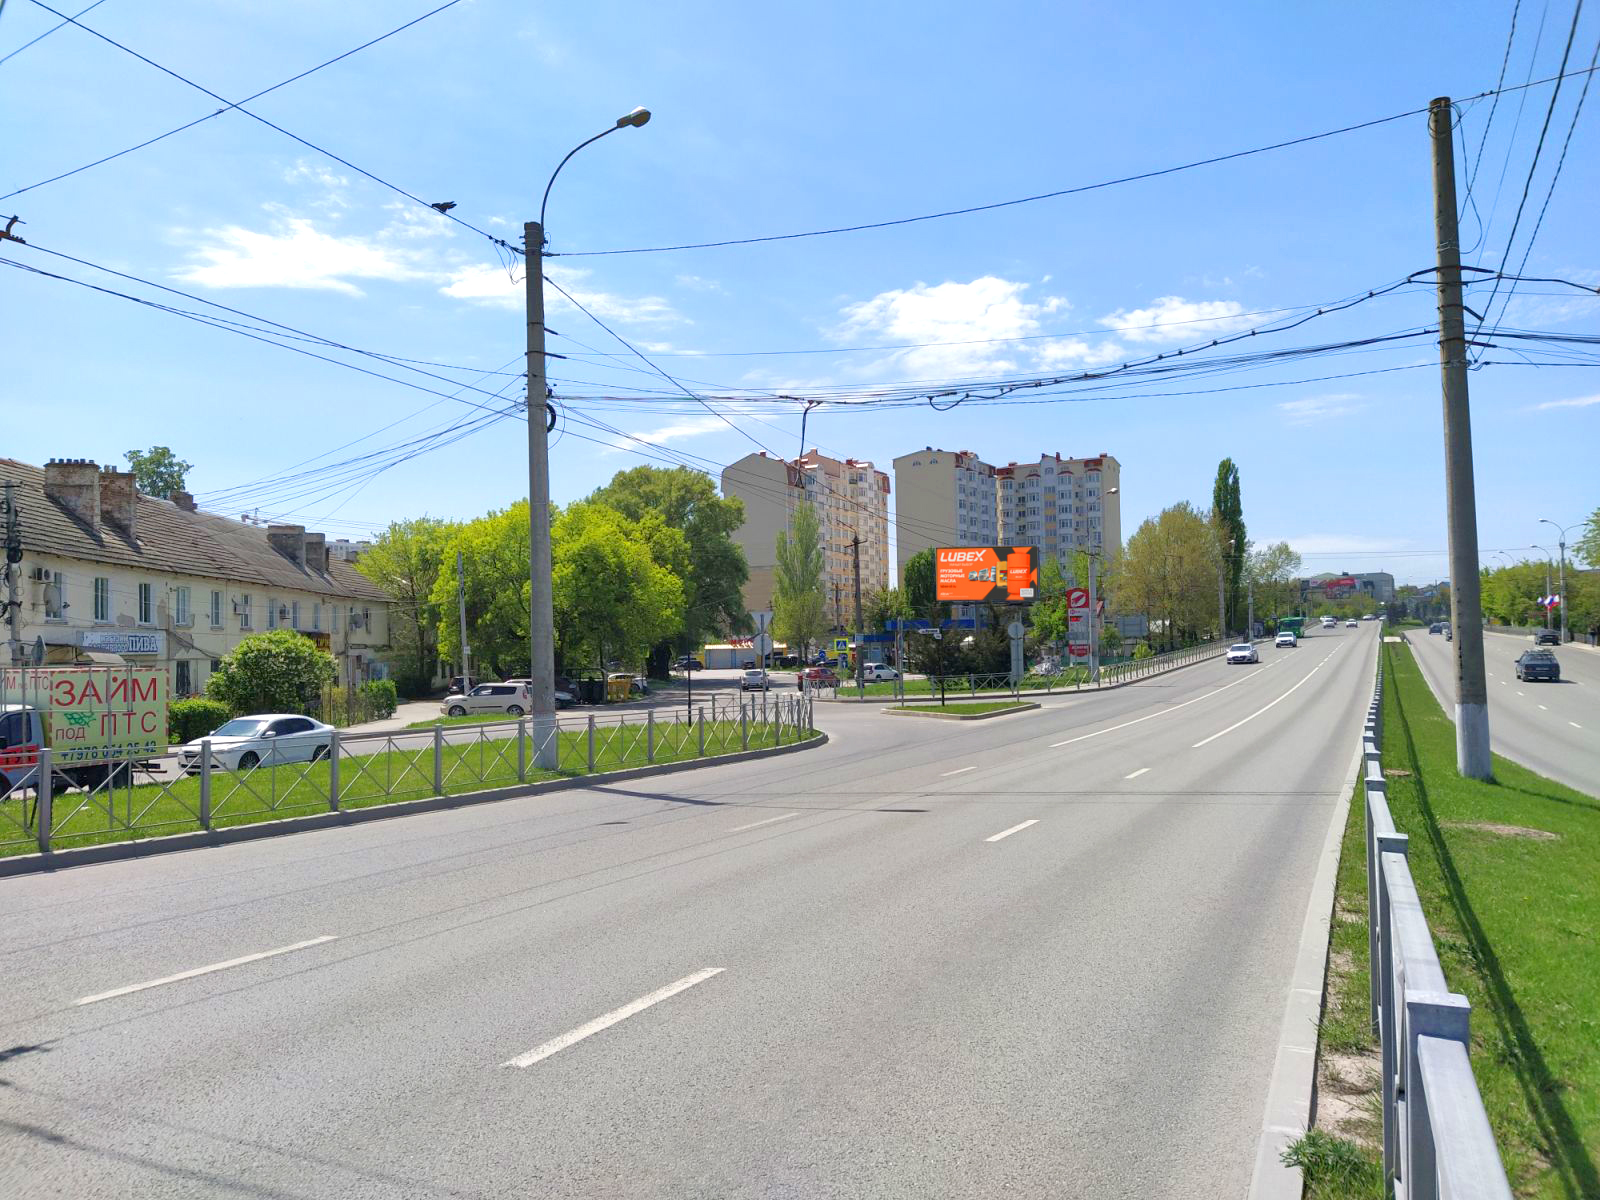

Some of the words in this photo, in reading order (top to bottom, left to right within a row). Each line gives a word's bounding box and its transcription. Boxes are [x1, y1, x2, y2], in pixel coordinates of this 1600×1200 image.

[940, 549, 987, 562] LUBEX
[128, 635, 158, 652] ПИВА
[55, 676, 157, 706] ЗАЙМ
[100, 711, 157, 737] ПТС
[56, 726, 86, 741] под
